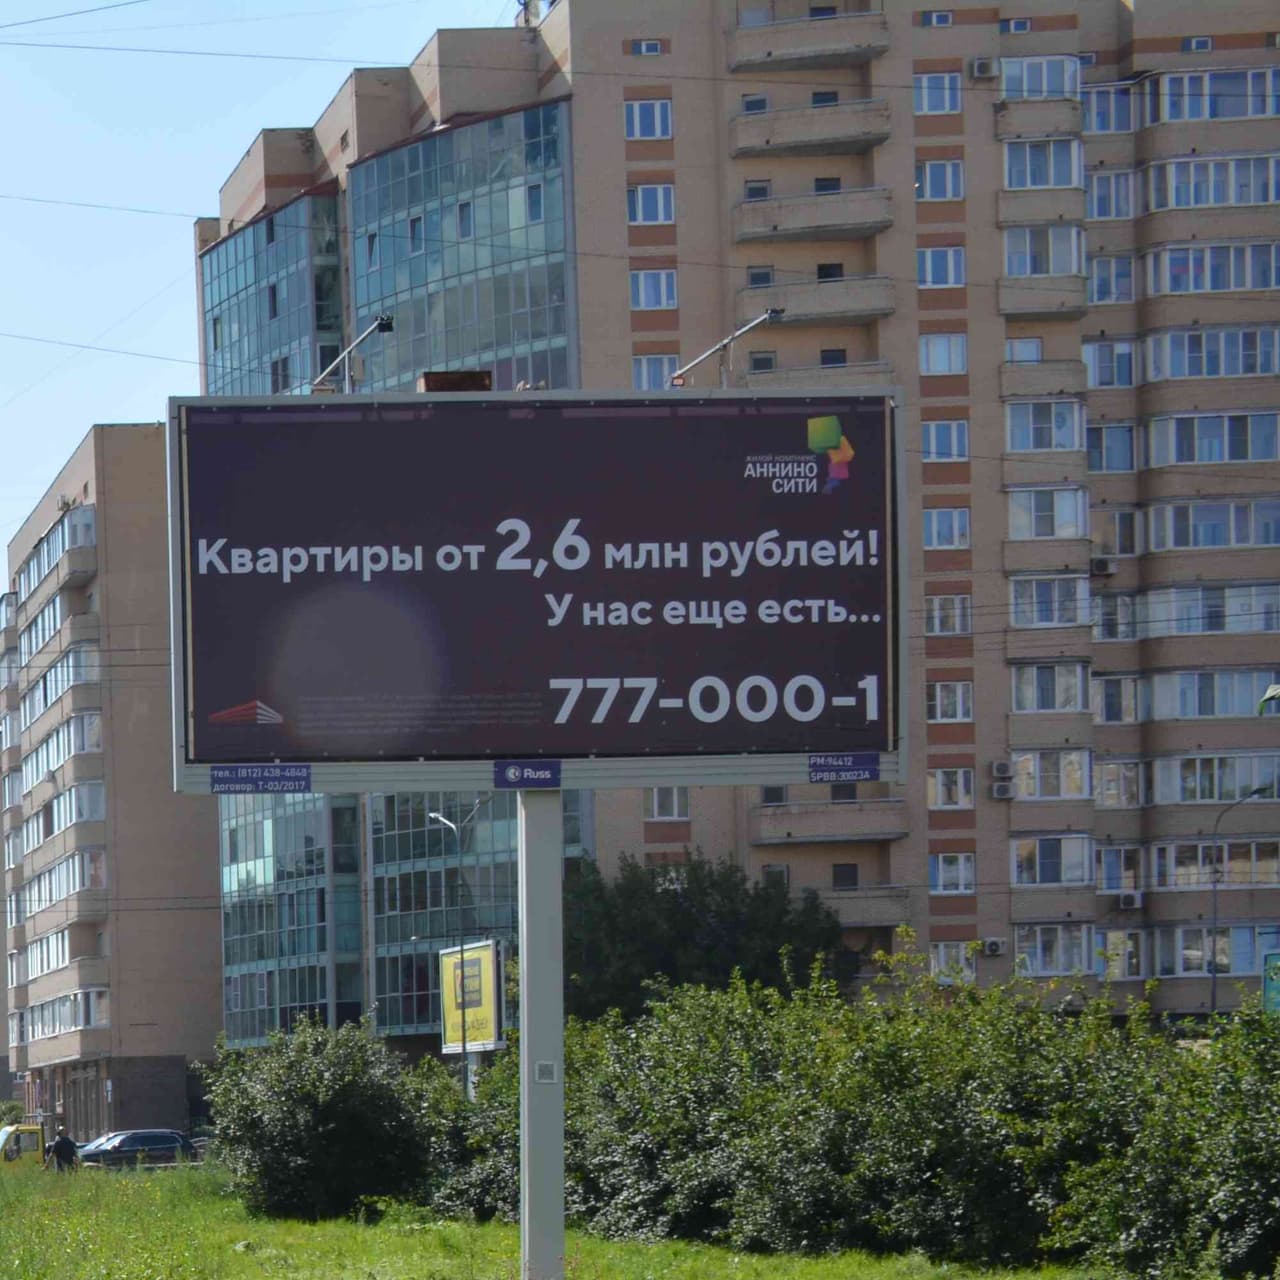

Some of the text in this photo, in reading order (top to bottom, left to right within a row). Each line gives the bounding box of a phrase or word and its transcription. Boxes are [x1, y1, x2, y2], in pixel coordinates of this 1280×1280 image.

[743, 462, 818, 478] АННИНО
[772, 478, 817, 493] СИТИ
[197, 518, 878, 583] Квартиры от 2,6 млн рублей!
[544, 593, 881, 628] У нас еще есть...
[549, 674, 878, 724] 777-000-1
[237, 768, 261, 778] (812)
[523, 767, 551, 779] Russ
